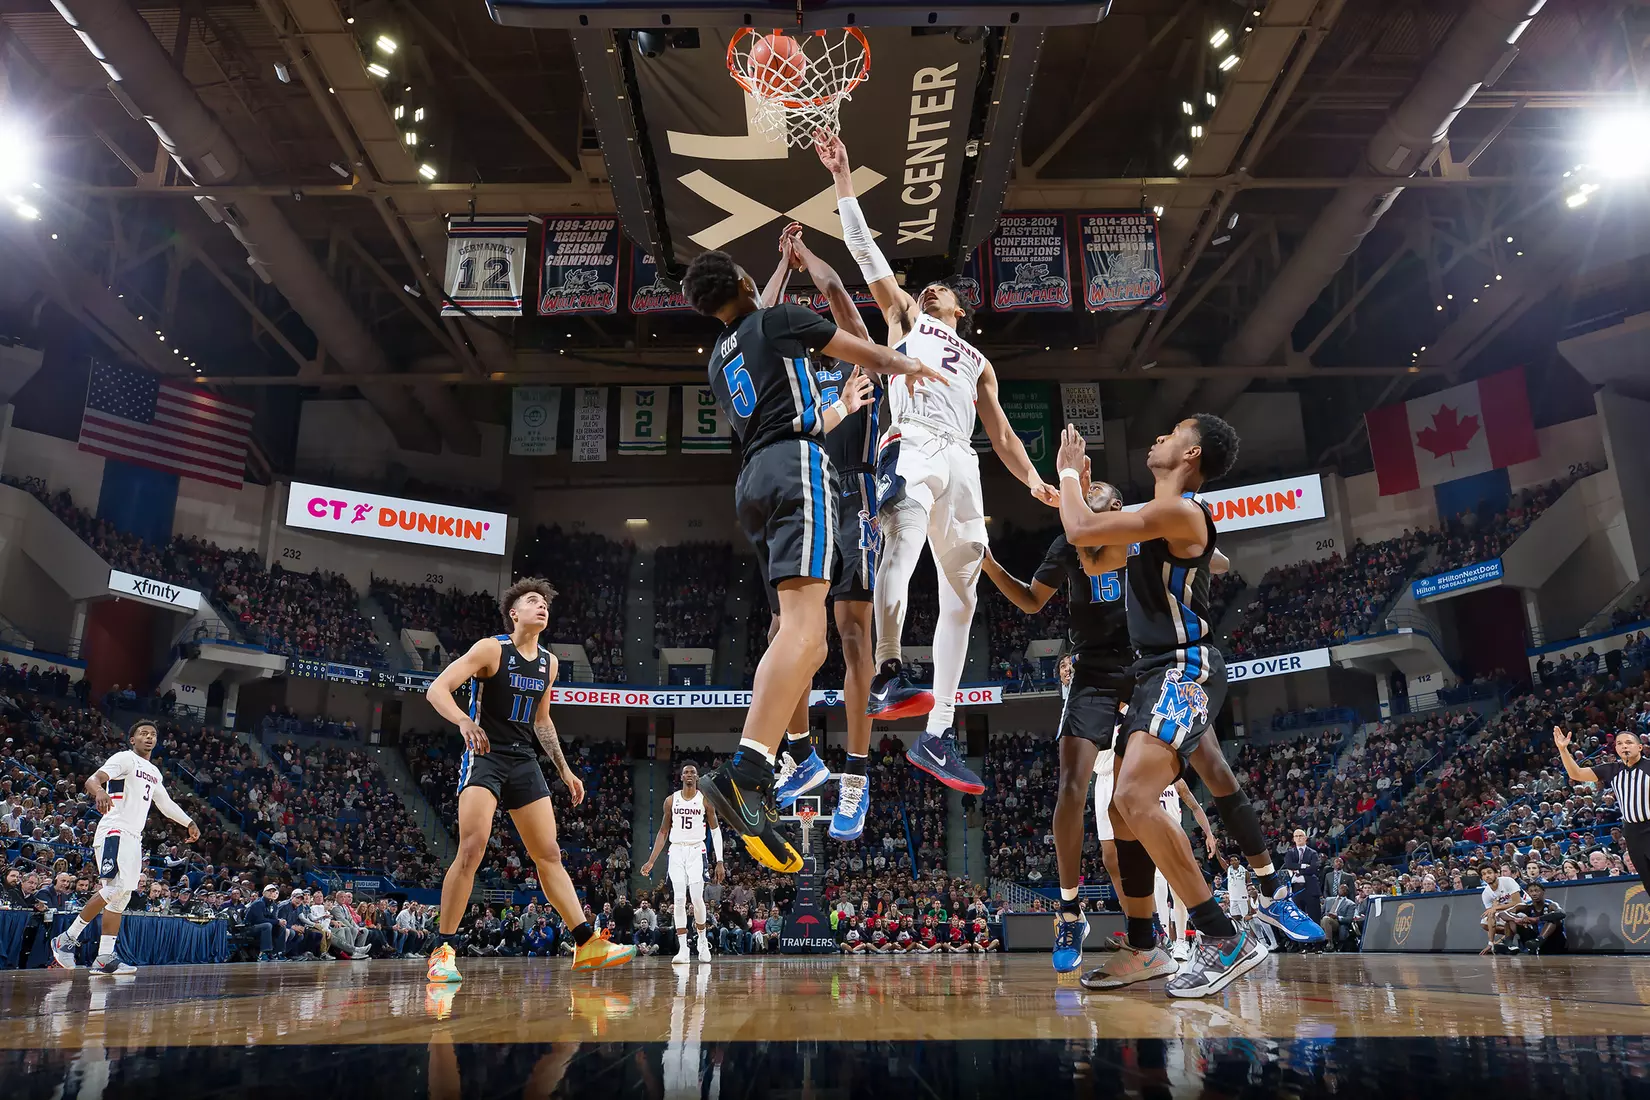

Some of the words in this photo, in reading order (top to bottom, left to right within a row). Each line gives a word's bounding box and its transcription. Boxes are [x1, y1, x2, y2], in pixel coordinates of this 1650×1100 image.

[901, 62, 959, 206] CENTER
[549, 219, 615, 231] 1999-2000
[897, 208, 937, 245] XL
[1000, 218, 1058, 226] 2003-2004
[1089, 217, 1147, 225] 2014-2015
[1002, 227, 1054, 236] EASTERN
[1084, 226, 1154, 234] NORTHEAST
[553, 232, 608, 243] REGULAR
[994, 237, 1061, 246] CONFERENCE
[1093, 234, 1146, 243] DIVISION
[557, 243, 604, 254] SEASON
[994, 247, 1061, 256] CHAMPIONS
[1086, 243, 1155, 252] CHAMPIONS
[545, 255, 614, 266] CHAMPIONS
[458, 256, 511, 291] 12
[577, 292, 612, 307] PACK
[1032, 287, 1065, 302] PACK
[720, 331, 738, 359] ELLIS
[919, 324, 982, 368] UCONN
[941, 346, 961, 375] 2
[815, 370, 843, 383] ers
[722, 352, 758, 418] 5
[698, 408, 716, 434] 5
[1009, 411, 1043, 419] CHAMPIONS
[635, 410, 652, 437] 2
[1208, 488, 1302, 522] UNKIN'
[307, 497, 348, 520] CT
[378, 507, 490, 541] DUNKIN'
[1315, 538, 1335, 551] 240
[282, 547, 302, 560] 232
[426, 573, 444, 584] 233
[1437, 564, 1499, 585] #HiltonNextDoor
[1450, 578, 1467, 588] DEALS
[1466, 575, 1479, 583] AND
[1478, 570, 1500, 580] OFFERS
[132, 579, 181, 603] xfinity
[1089, 571, 1121, 604] 15
[1416, 585, 1436, 596] Hilton
[354, 669, 364, 678] 15
[1227, 665, 1247, 680] ED
[1252, 656, 1302, 675] OVER
[378, 672, 395, 682] 9:41
[404, 676, 412, 685] 11
[508, 672, 545, 692] Tigers
[1417, 674, 1432, 684] 112
[181, 684, 197, 693] 107
[550, 690, 559, 702] E
[564, 690, 621, 705] SOBER
[625, 693, 649, 705] OR
[653, 693, 686, 706] GET
[690, 693, 753, 706] PULLED
[968, 689, 993, 703] OR
[507, 693, 535, 724] 11
[142, 784, 151, 802] 3
[681, 816, 693, 830] 15
[1395, 915, 1413, 938] ups
[782, 937, 833, 947] TRAVELERS
